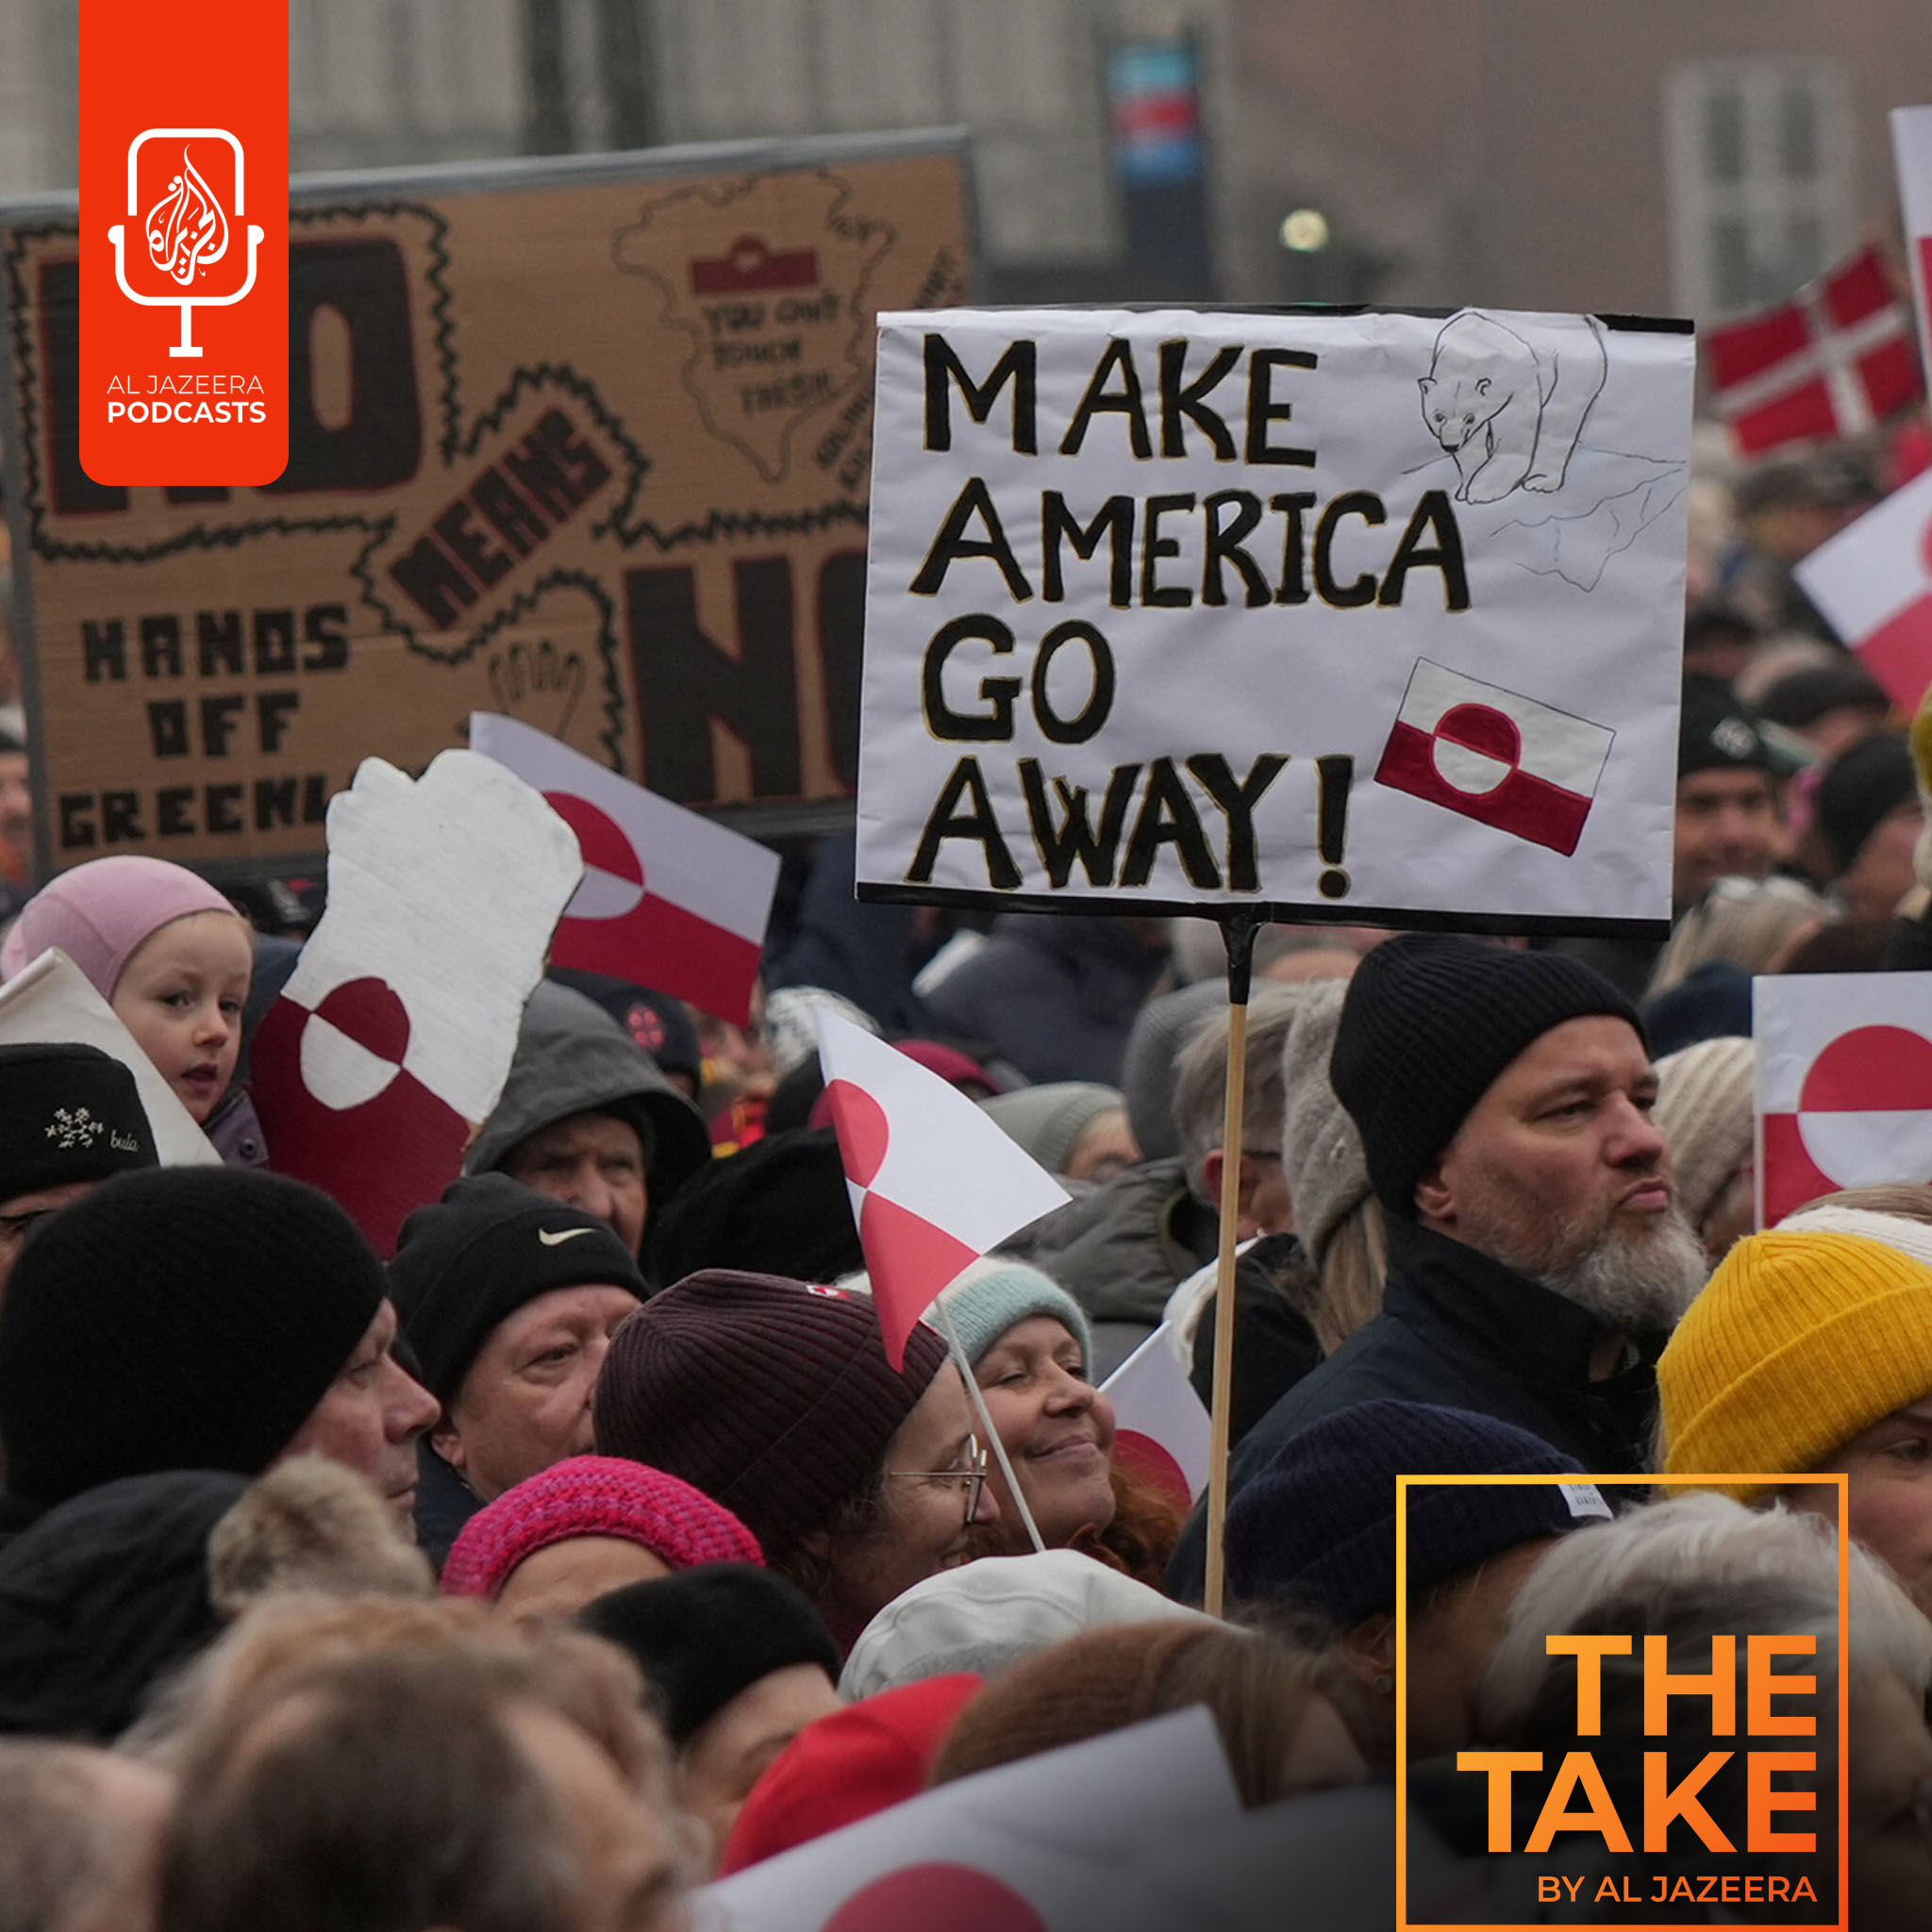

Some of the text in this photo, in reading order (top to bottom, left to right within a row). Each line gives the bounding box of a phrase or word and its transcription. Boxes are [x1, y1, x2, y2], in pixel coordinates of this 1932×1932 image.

[923, 333, 1319, 469] MAKE
[388, 407, 613, 630] MEANS
[908, 476, 1472, 614] AMERICA
[81, 603, 350, 683] HANDS
[923, 613, 1115, 746] GO
[146, 690, 301, 758] OFF
[903, 753, 1355, 900] AWAY!
